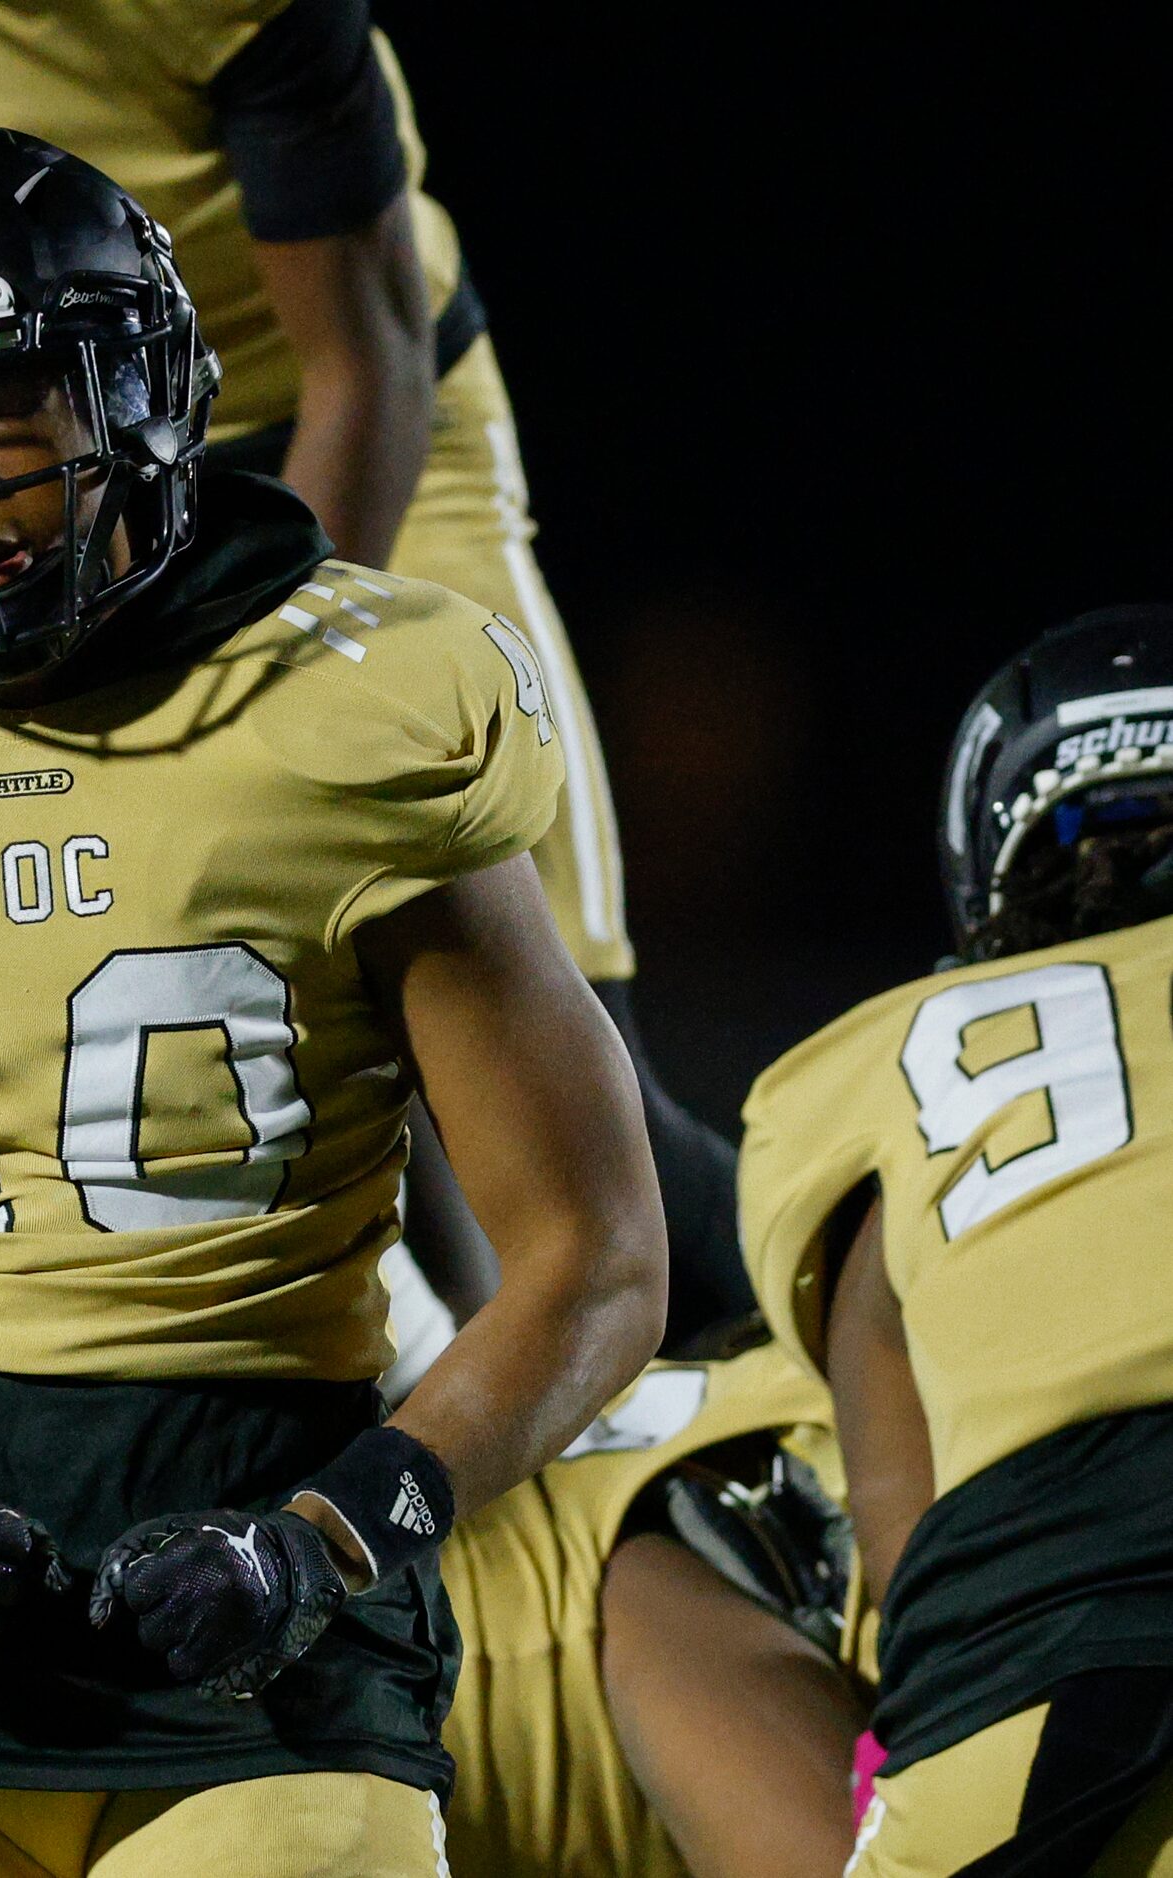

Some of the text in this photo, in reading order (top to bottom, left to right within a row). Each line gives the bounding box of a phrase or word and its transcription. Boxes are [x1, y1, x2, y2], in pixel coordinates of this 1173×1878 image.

[482, 611, 558, 747] 4
[899, 960, 1173, 1243] 9
[399, 1470, 436, 1535] adidas
